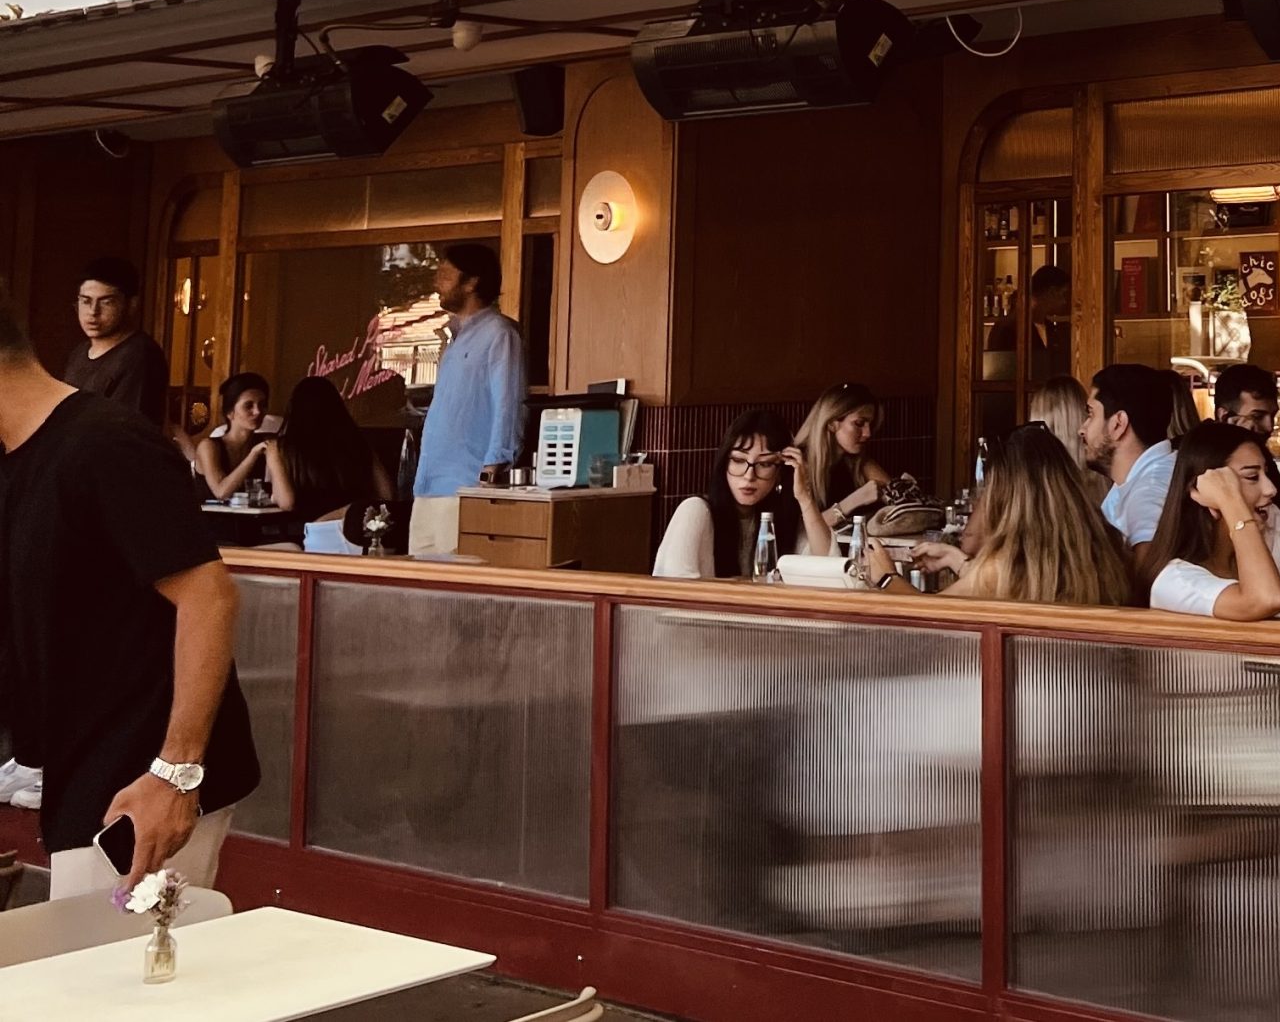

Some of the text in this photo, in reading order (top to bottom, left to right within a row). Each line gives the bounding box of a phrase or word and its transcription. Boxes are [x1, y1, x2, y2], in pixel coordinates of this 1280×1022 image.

[1241, 255, 1275, 274] chic
[1239, 287, 1274, 307] dogs
[306, 336, 359, 378] Shared
